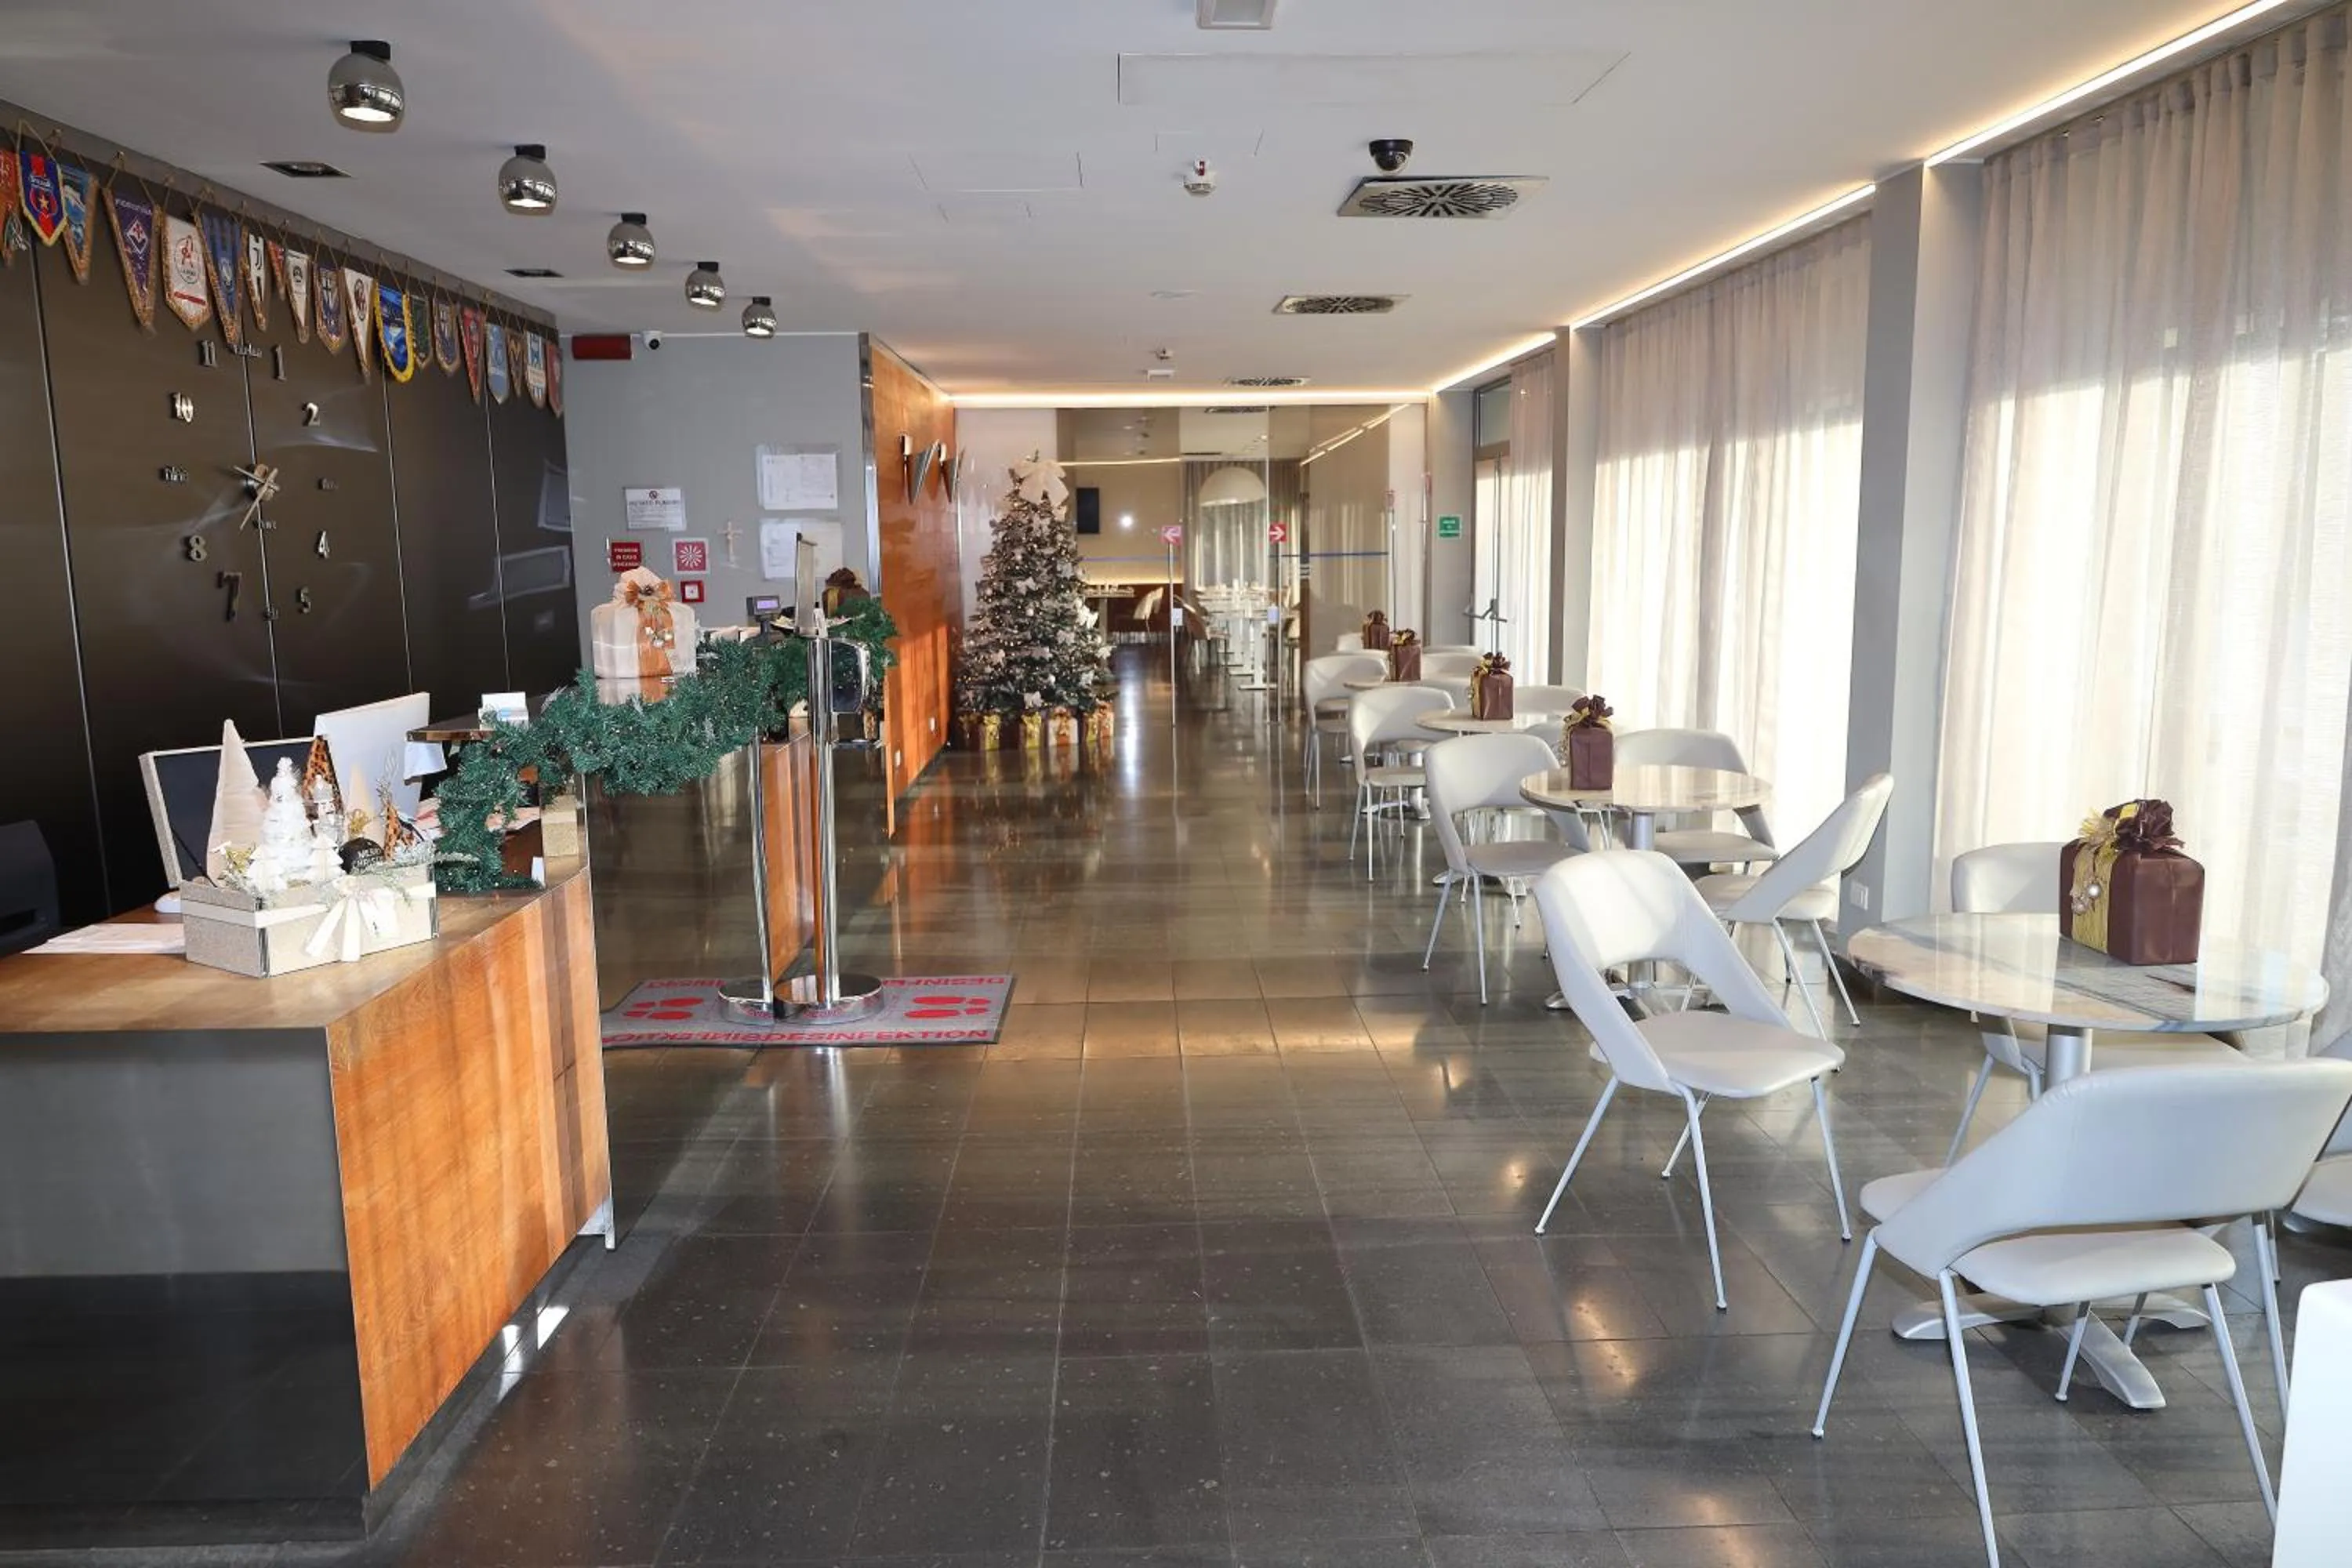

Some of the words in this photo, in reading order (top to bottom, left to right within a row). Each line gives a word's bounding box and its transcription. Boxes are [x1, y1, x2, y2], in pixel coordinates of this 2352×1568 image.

[172, 392, 194, 423] 10
[303, 401, 321, 426] 2
[188, 535, 208, 561] 8
[318, 531, 330, 559] 4
[220, 571, 243, 620] 7
[299, 586, 312, 615] 5
